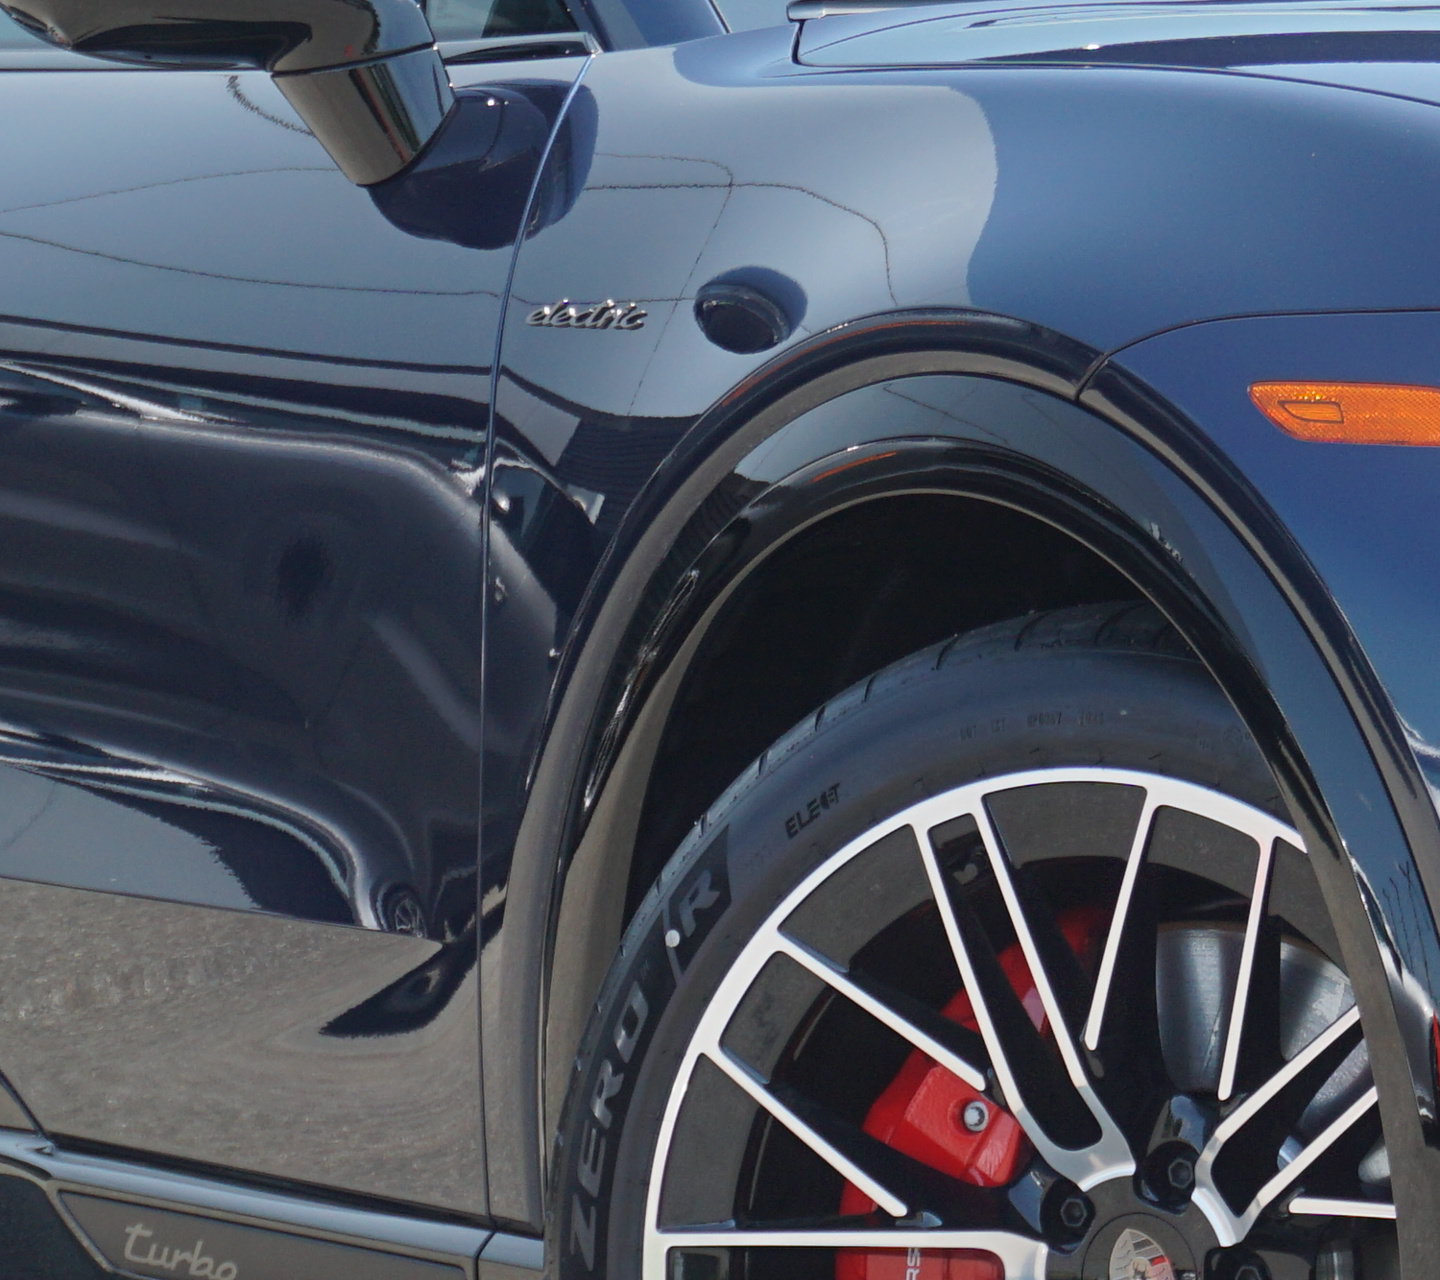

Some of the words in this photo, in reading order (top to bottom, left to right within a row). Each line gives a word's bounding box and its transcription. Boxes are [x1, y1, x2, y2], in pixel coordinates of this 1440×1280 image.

[526, 297, 649, 331] electric
[569, 979, 648, 1272] ZERO
[679, 867, 721, 941] R
